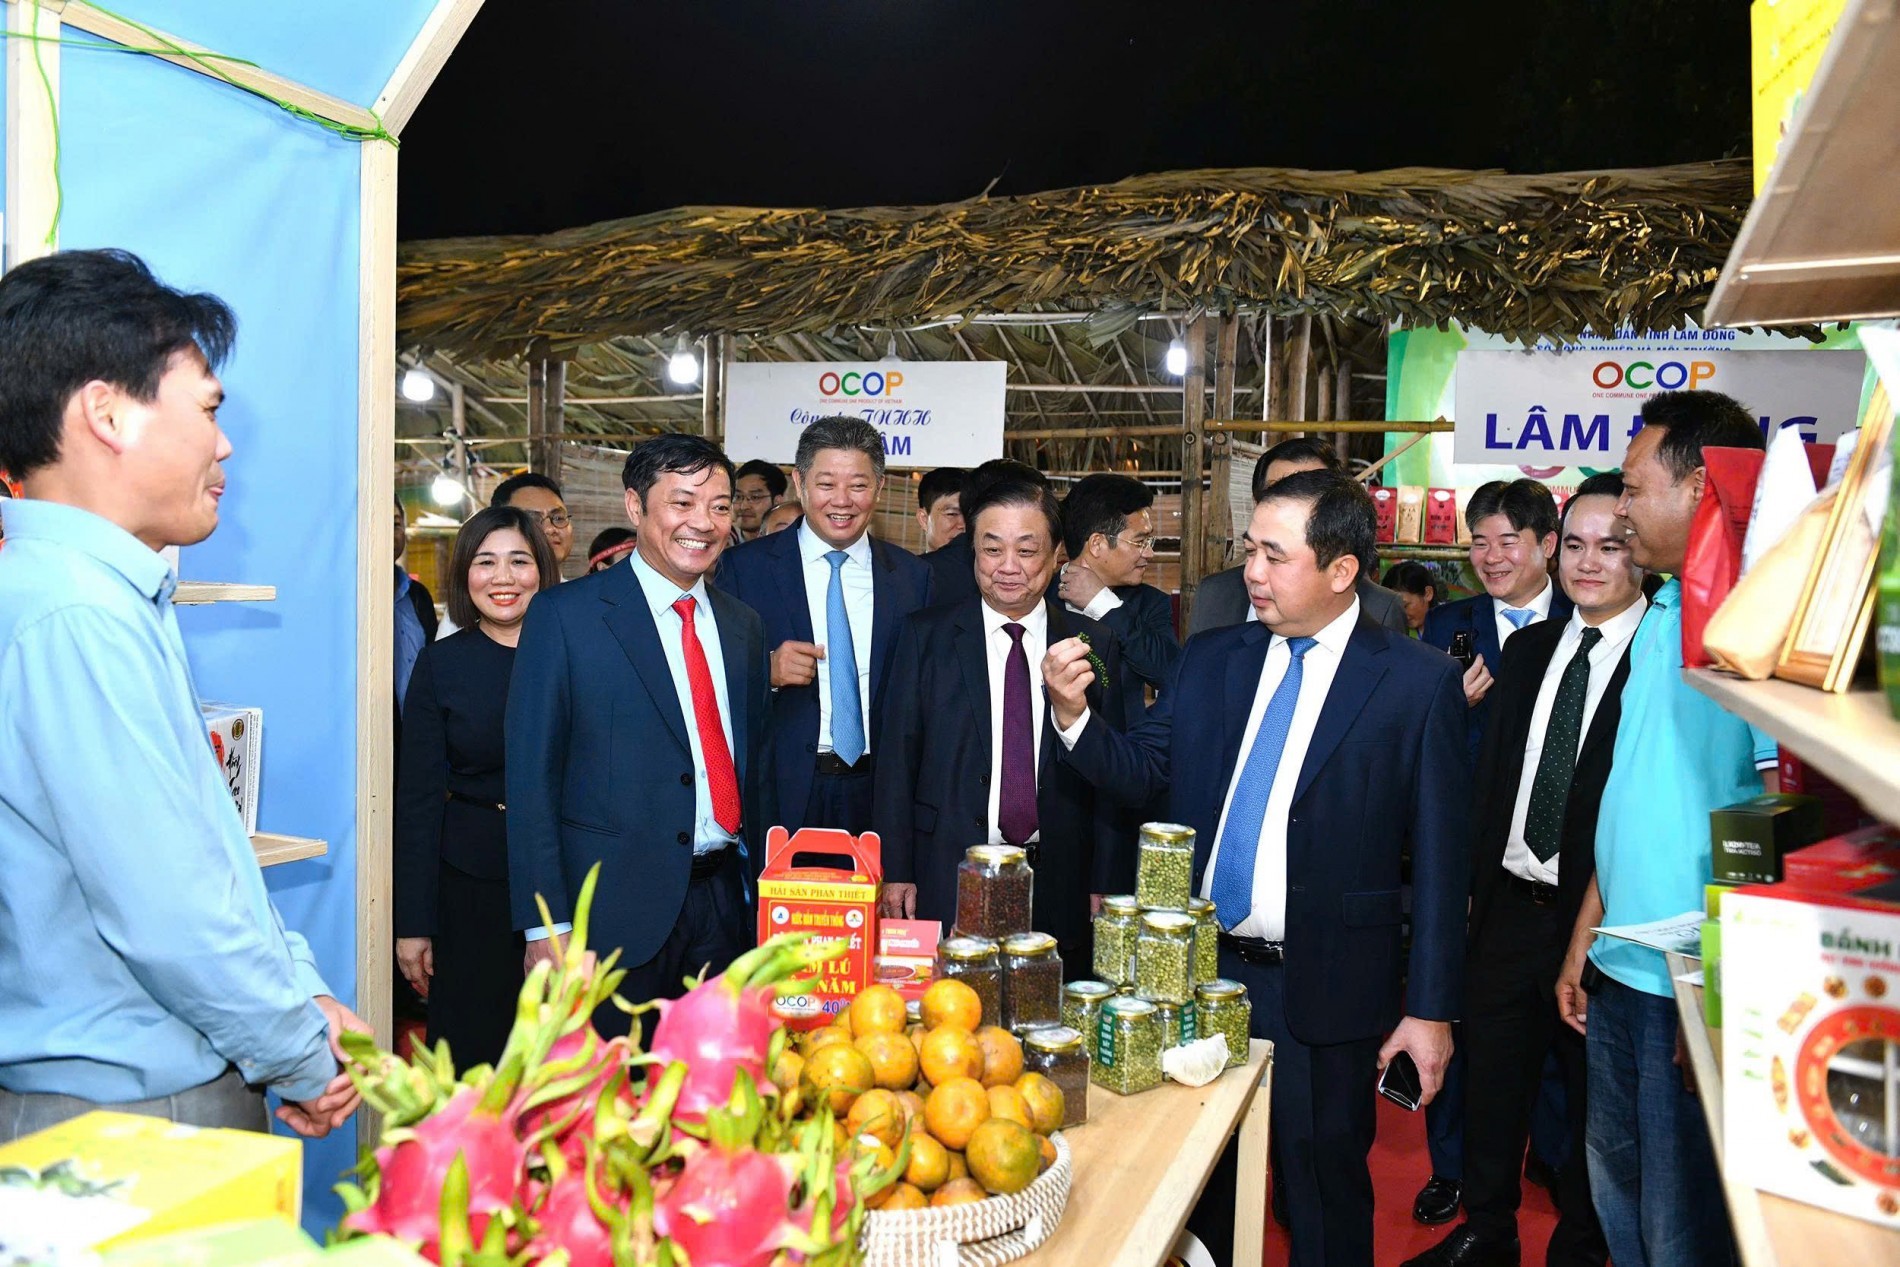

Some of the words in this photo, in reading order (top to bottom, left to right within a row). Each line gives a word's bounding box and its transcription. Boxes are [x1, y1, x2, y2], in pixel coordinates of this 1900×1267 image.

[819, 372, 904, 396] OCOP
[1592, 361, 1716, 390] OCOP
[790, 408, 826, 425] Côn
[860, 408, 932, 425] TNHH
[1485, 405, 1610, 452] LÂM
[810, 889, 835, 898] PHAN
[839, 889, 867, 900] THIẾT
[816, 977, 856, 995] NĂM
[776, 995, 816, 1007] OCOP
